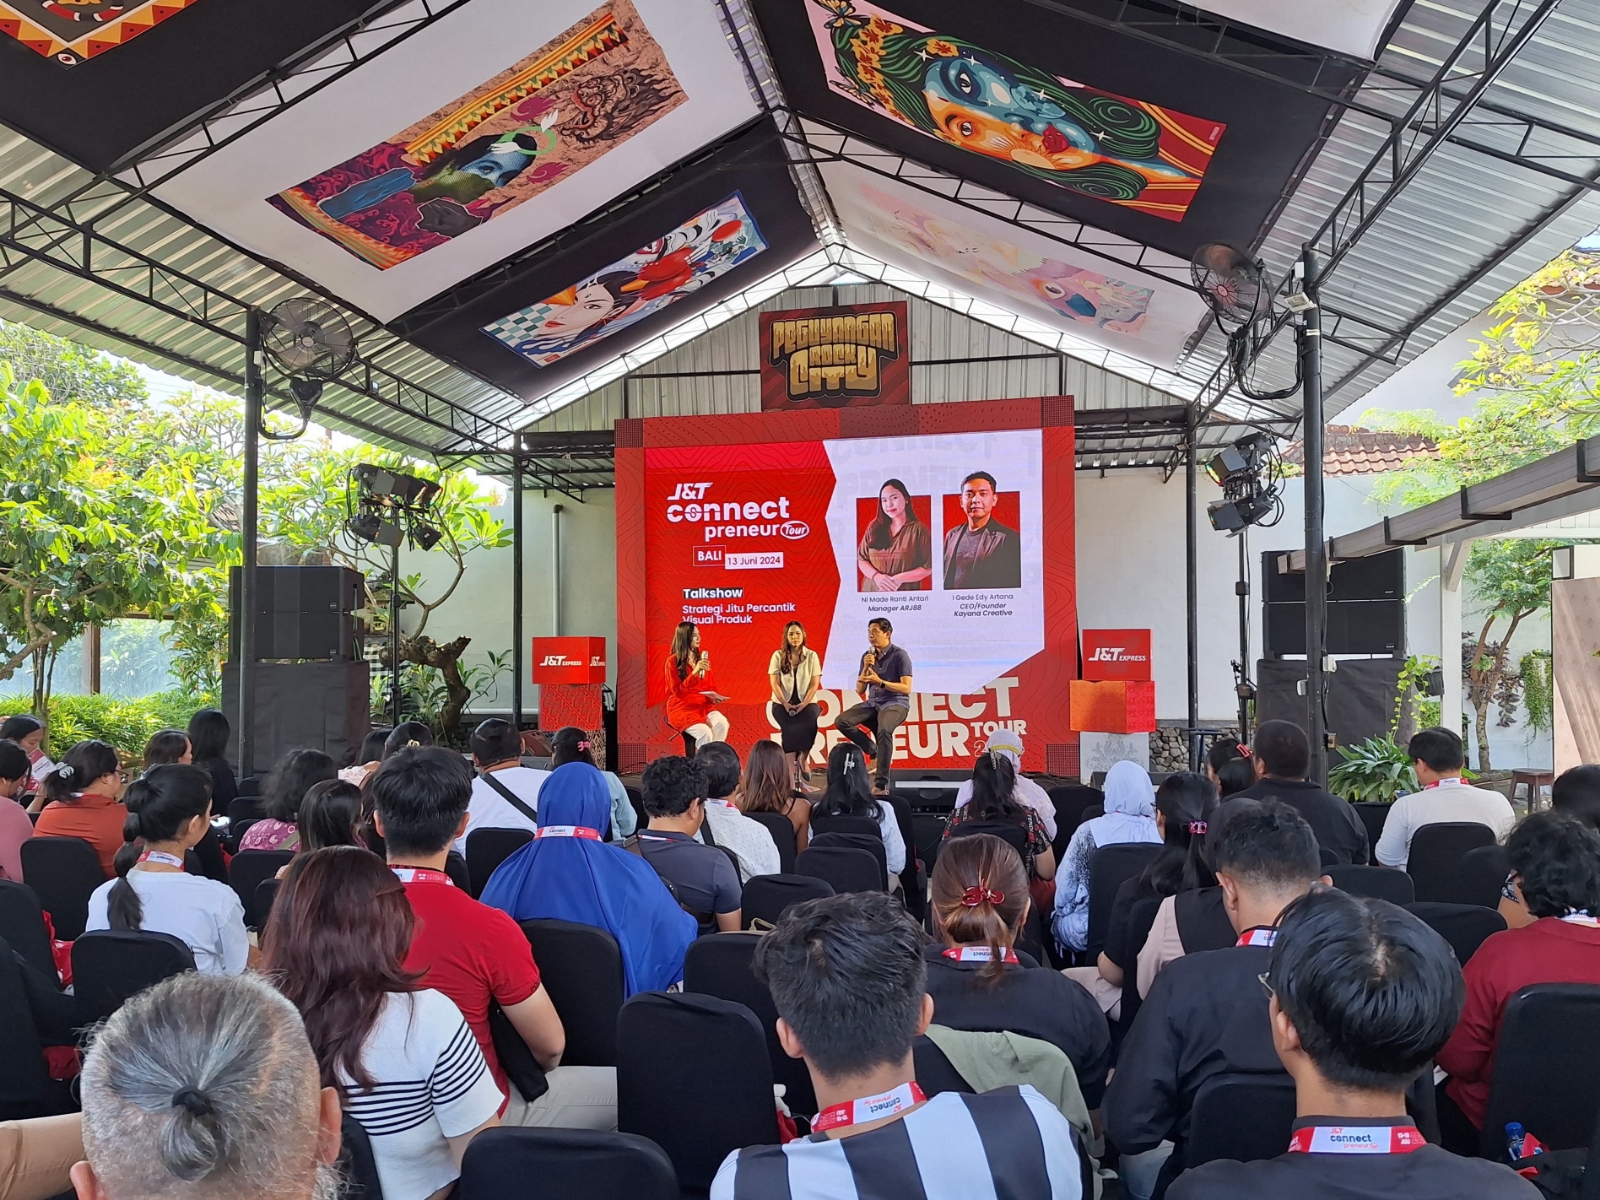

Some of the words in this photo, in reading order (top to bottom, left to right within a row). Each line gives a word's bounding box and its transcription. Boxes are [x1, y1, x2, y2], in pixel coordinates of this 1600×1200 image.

[809, 343, 857, 366] ROCK
[789, 346, 878, 396] CITY
[667, 482, 713, 501] J&T
[667, 496, 790, 523] connect
[705, 523, 780, 542] preneur
[784, 523, 807, 536] Tour
[697, 550, 722, 562] BALI
[727, 557, 737, 566] 13
[740, 556, 758, 566] Juni
[759, 555, 781, 565] 2024
[683, 587, 743, 599] Talkshow
[890, 595, 907, 603] Ranti
[975, 594, 988, 602] Edy
[989, 593, 1014, 601] Artana
[682, 604, 723, 616] Strategi
[725, 604, 744, 613] Jitu
[746, 602, 796, 613] Percantik
[868, 605, 899, 613] Manager
[953, 610, 981, 618] Kayana
[716, 614, 753, 624] Produk
[539, 655, 567, 666] J&T
[1088, 647, 1125, 662] J&T
[869, 1097, 901, 1114] connect
[1330, 1133, 1372, 1143] connect
